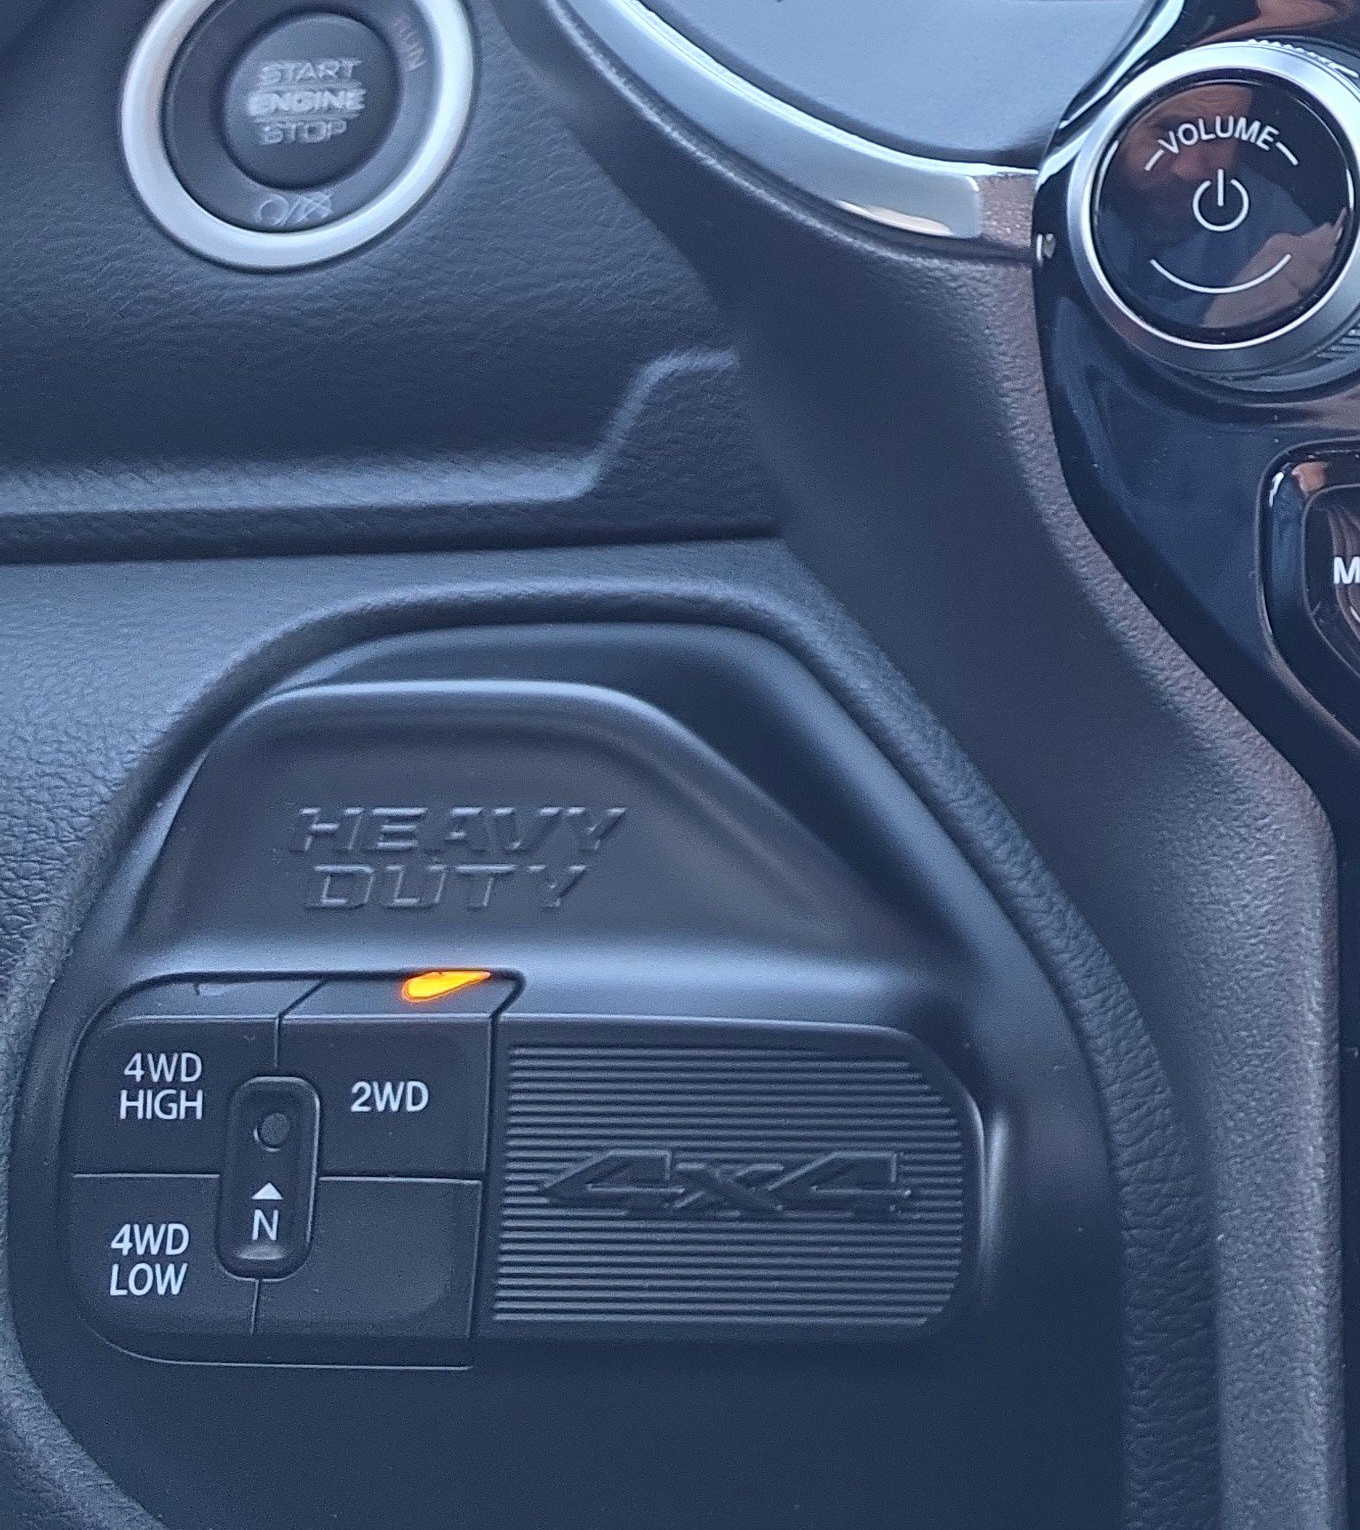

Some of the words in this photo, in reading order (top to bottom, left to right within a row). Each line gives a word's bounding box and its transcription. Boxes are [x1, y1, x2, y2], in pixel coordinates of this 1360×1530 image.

[258, 58, 362, 86] START
[259, 119, 348, 145] STOP
[1157, 114, 1280, 155] VOLUME
[292, 806, 628, 852] HEAVY
[305, 864, 587, 910] DUTY
[123, 1052, 203, 1083] 4WD
[118, 1088, 204, 1120] HIGH
[350, 1080, 430, 1113] 2WD
[110, 1222, 190, 1256] 4WD
[250, 1208, 279, 1241] N
[109, 1262, 189, 1297] LOW
